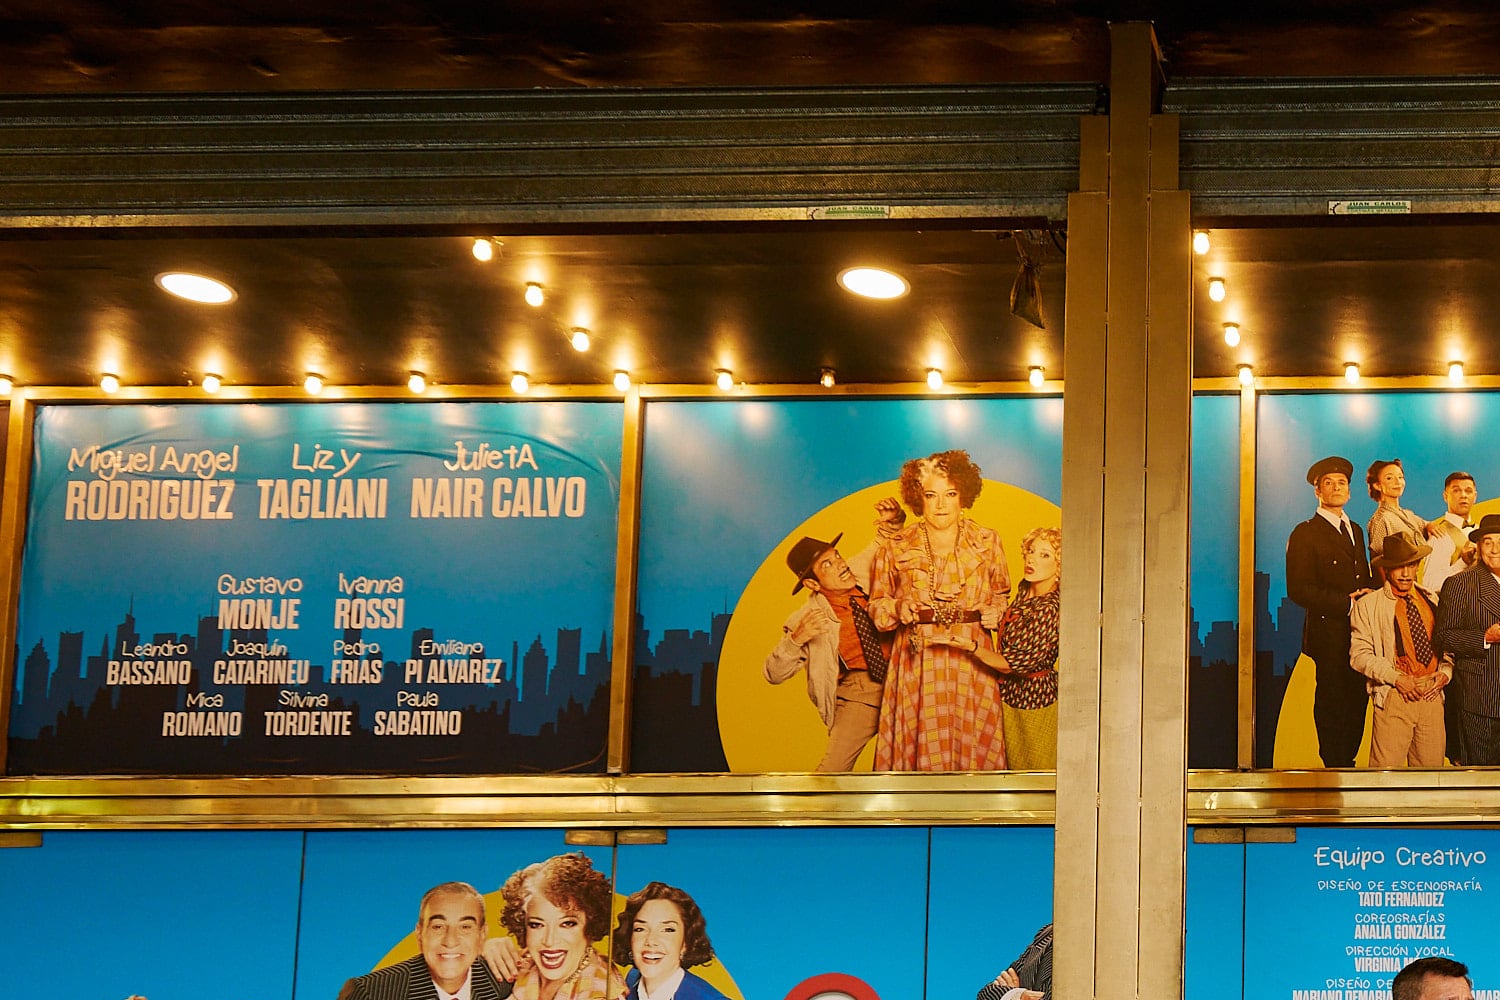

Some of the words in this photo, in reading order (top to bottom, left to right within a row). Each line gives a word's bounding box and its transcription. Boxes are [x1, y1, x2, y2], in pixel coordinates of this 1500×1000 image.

[67, 445, 155, 481] Miguel
[160, 445, 240, 479] Angel
[292, 443, 361, 478] Lizy
[65, 480, 235, 521] RODRIGUEZ
[257, 478, 388, 520] TAGLIANI
[410, 477, 485, 520] NAIR
[492, 476, 586, 519] CALVO
[217, 573, 303, 596] Gustavo
[338, 572, 404, 595] Ivanna
[217, 598, 300, 631] MONJE
[334, 597, 404, 630] ROSSI
[122, 640, 188, 658] Leandro
[333, 639, 380, 657] Pedro
[419, 639, 484, 657] Emiliano
[106, 660, 192, 686] BASSANO
[213, 659, 310, 686] CATARINEU
[331, 659, 383, 685] FRIAS
[404, 659, 425, 685] PI
[427, 658, 502, 685] ALVAREZ
[186, 691, 223, 708] Mica
[278, 689, 328, 708] Silvina
[396, 690, 438, 708] Paula
[161, 711, 242, 737] ROMANO
[264, 711, 352, 736] TORDENTE
[374, 710, 461, 736] SABATINO
[1314, 846, 1385, 871] Equipo
[1396, 846, 1487, 867] Creativo
[1317, 878, 1362, 891] DISEÑO
[1367, 880, 1385, 891] DE
[1391, 876, 1482, 891] ESCENOGRAFÍA
[1358, 892, 1383, 907] TATO
[1384, 891, 1445, 907] FERNANDEZ
[1354, 910, 1445, 924] COREOGRAFÍAS
[1354, 922, 1392, 940] ANALÍA
[1394, 921, 1446, 940] GONZÁLEZ
[1345, 943, 1409, 957] DIRECCIÓN
[1414, 946, 1455, 958] VOCAL
[1354, 957, 1401, 973] VIRGINIA
[1325, 977, 1371, 990] DISEÑO
